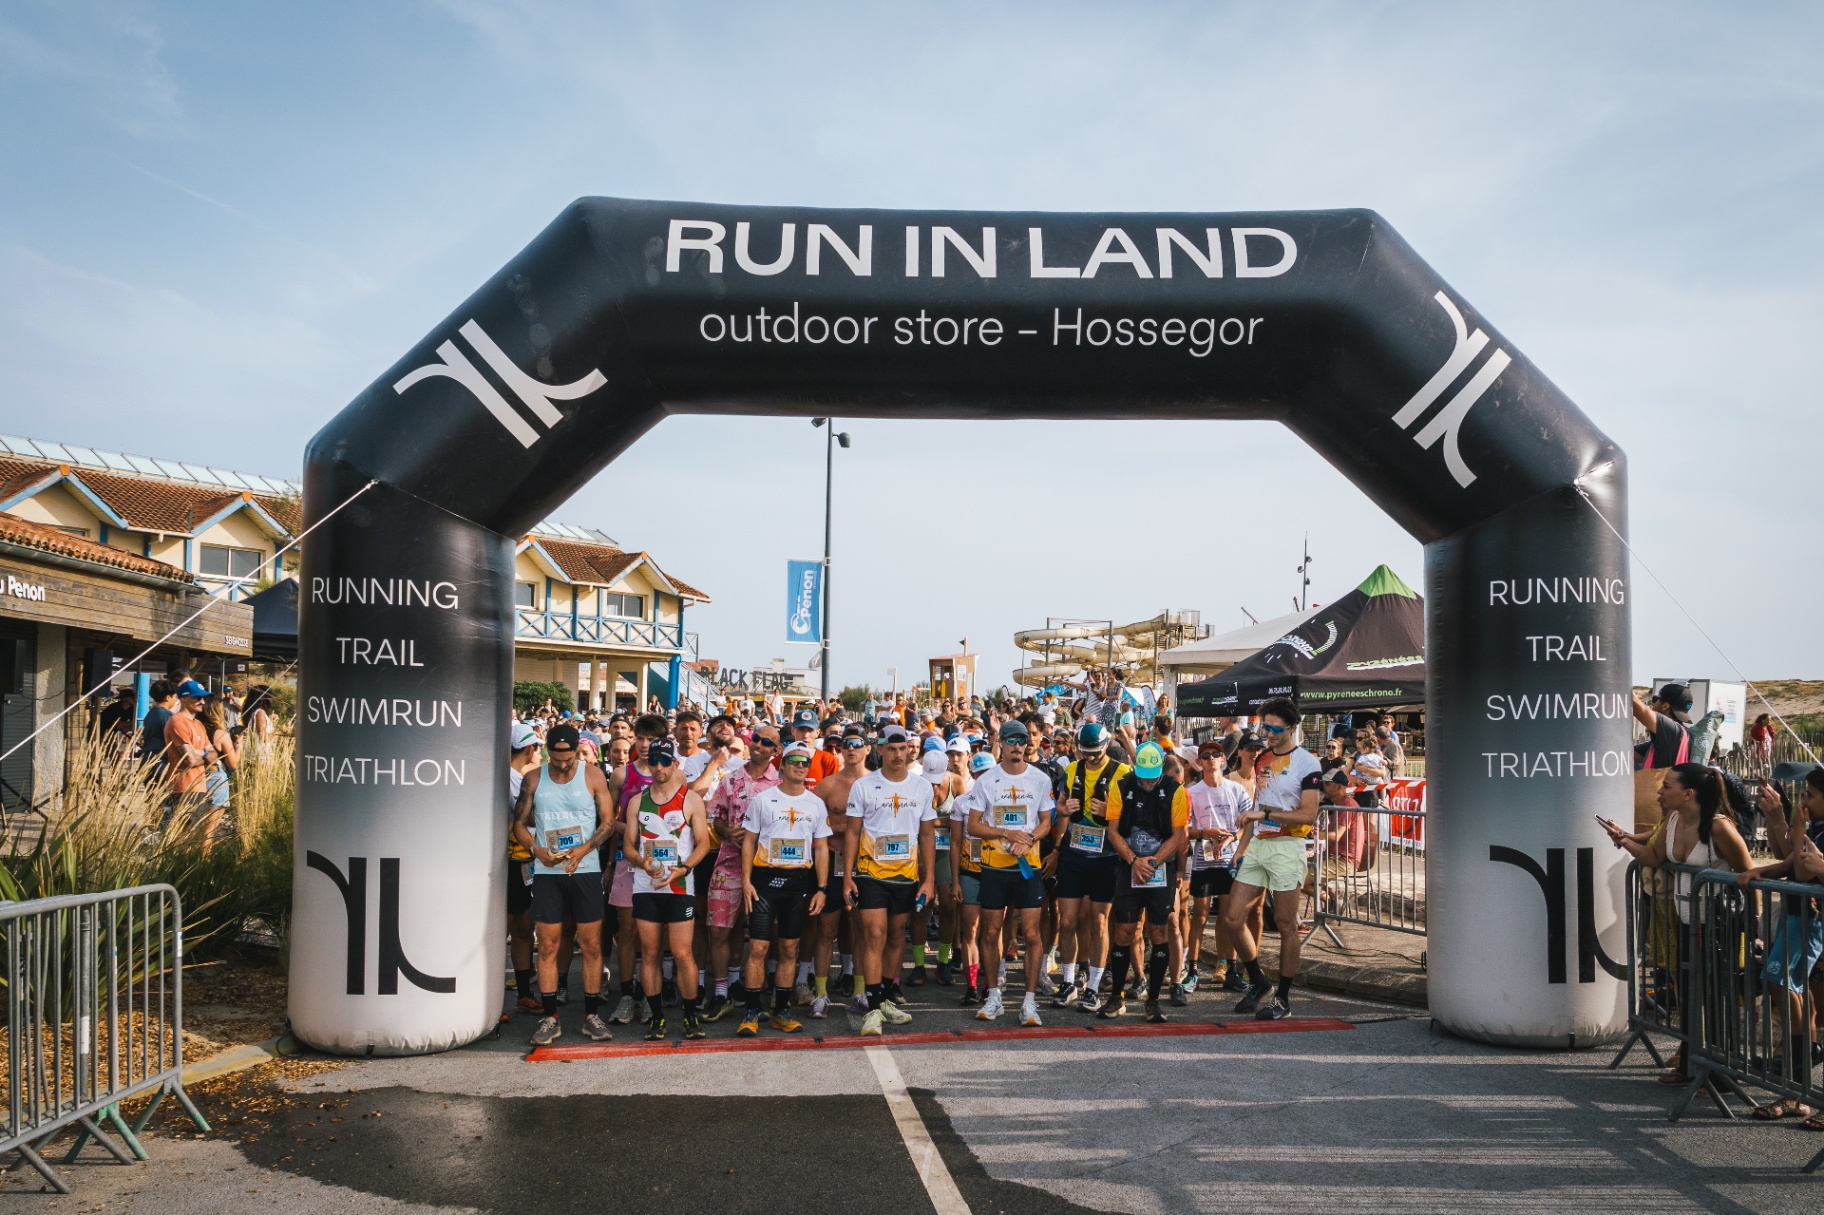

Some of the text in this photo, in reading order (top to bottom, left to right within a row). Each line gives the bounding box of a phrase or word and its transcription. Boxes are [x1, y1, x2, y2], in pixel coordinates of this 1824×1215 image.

[666, 219, 1298, 278] RUN IN LAND
[700, 302, 878, 343] outdoor
[894, 309, 1004, 346] store
[1053, 308, 1264, 357] Hossegor
[8, 575, 46, 602] Penon
[311, 577, 459, 610] RUNNING
[1489, 577, 1625, 605] RUNNING
[336, 637, 425, 667] TRAIL
[1525, 635, 1607, 662] TRAIL
[1303, 687, 1403, 700] www.pyreneeschrono.fr
[1486, 693, 1628, 721] SWIMRUN
[307, 695, 462, 727] SWIMRUN
[304, 754, 465, 786] TRIATHLON
[1482, 750, 1631, 778] TRIATHLON
[1005, 813, 1018, 822] 401
[560, 836, 574, 846] 709
[654, 848, 669, 858] 564
[782, 847, 796, 856] 444
[887, 843, 900, 851] 797
